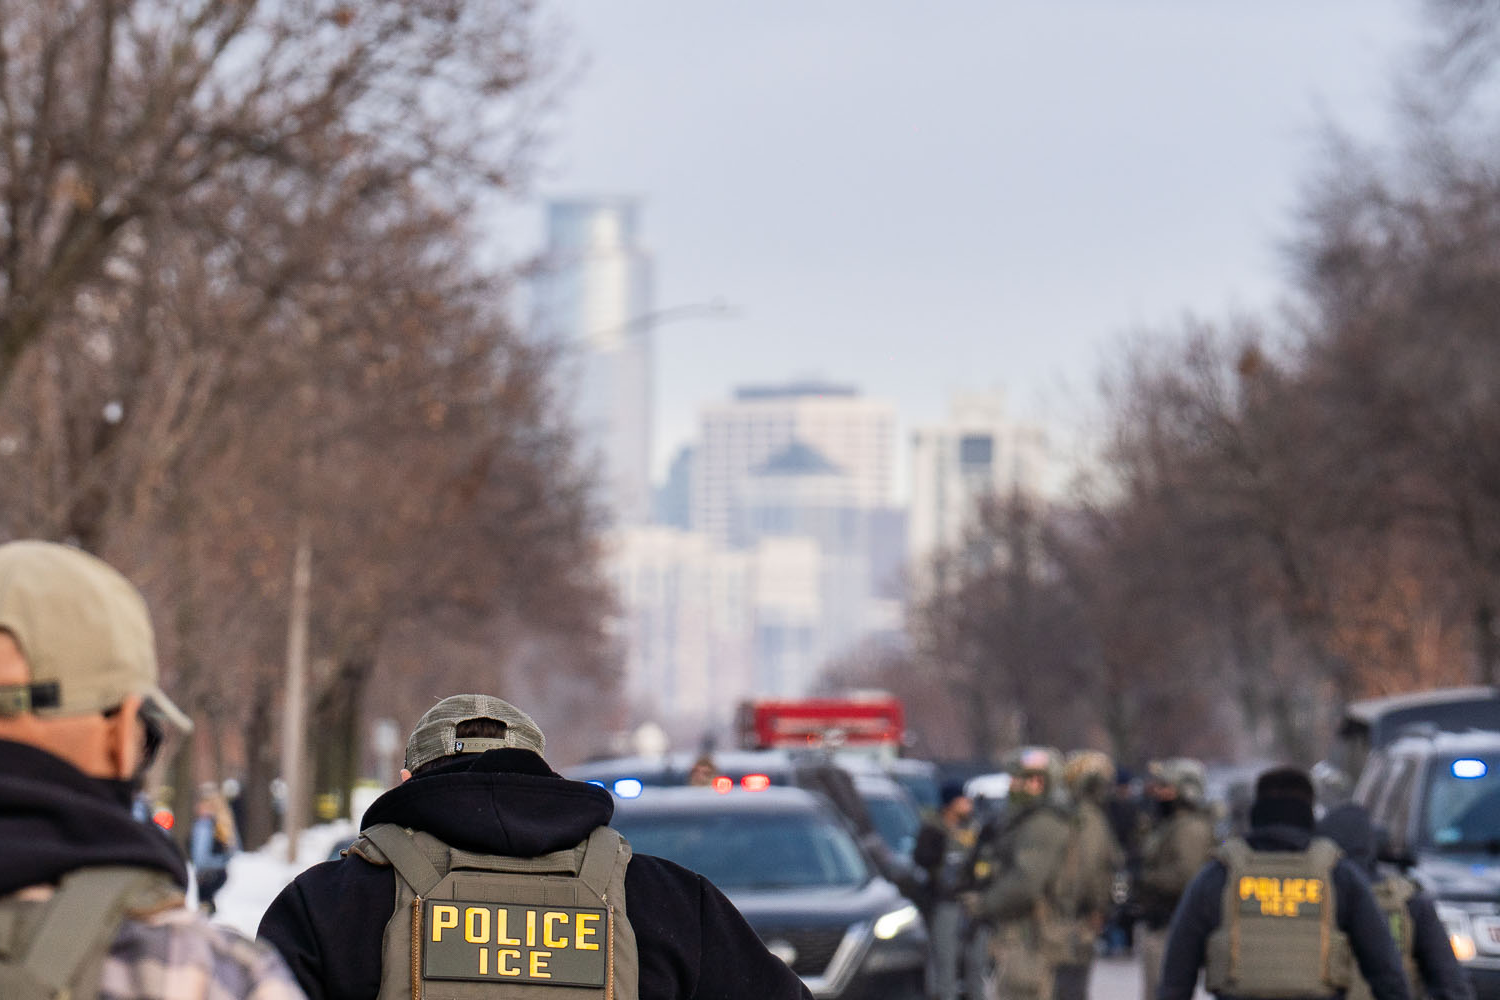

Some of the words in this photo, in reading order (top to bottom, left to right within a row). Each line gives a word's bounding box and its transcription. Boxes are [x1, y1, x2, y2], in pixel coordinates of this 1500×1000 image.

[1239, 876, 1324, 903] POLICE
[432, 905, 600, 950] POLICE
[478, 947, 552, 978] ICE
